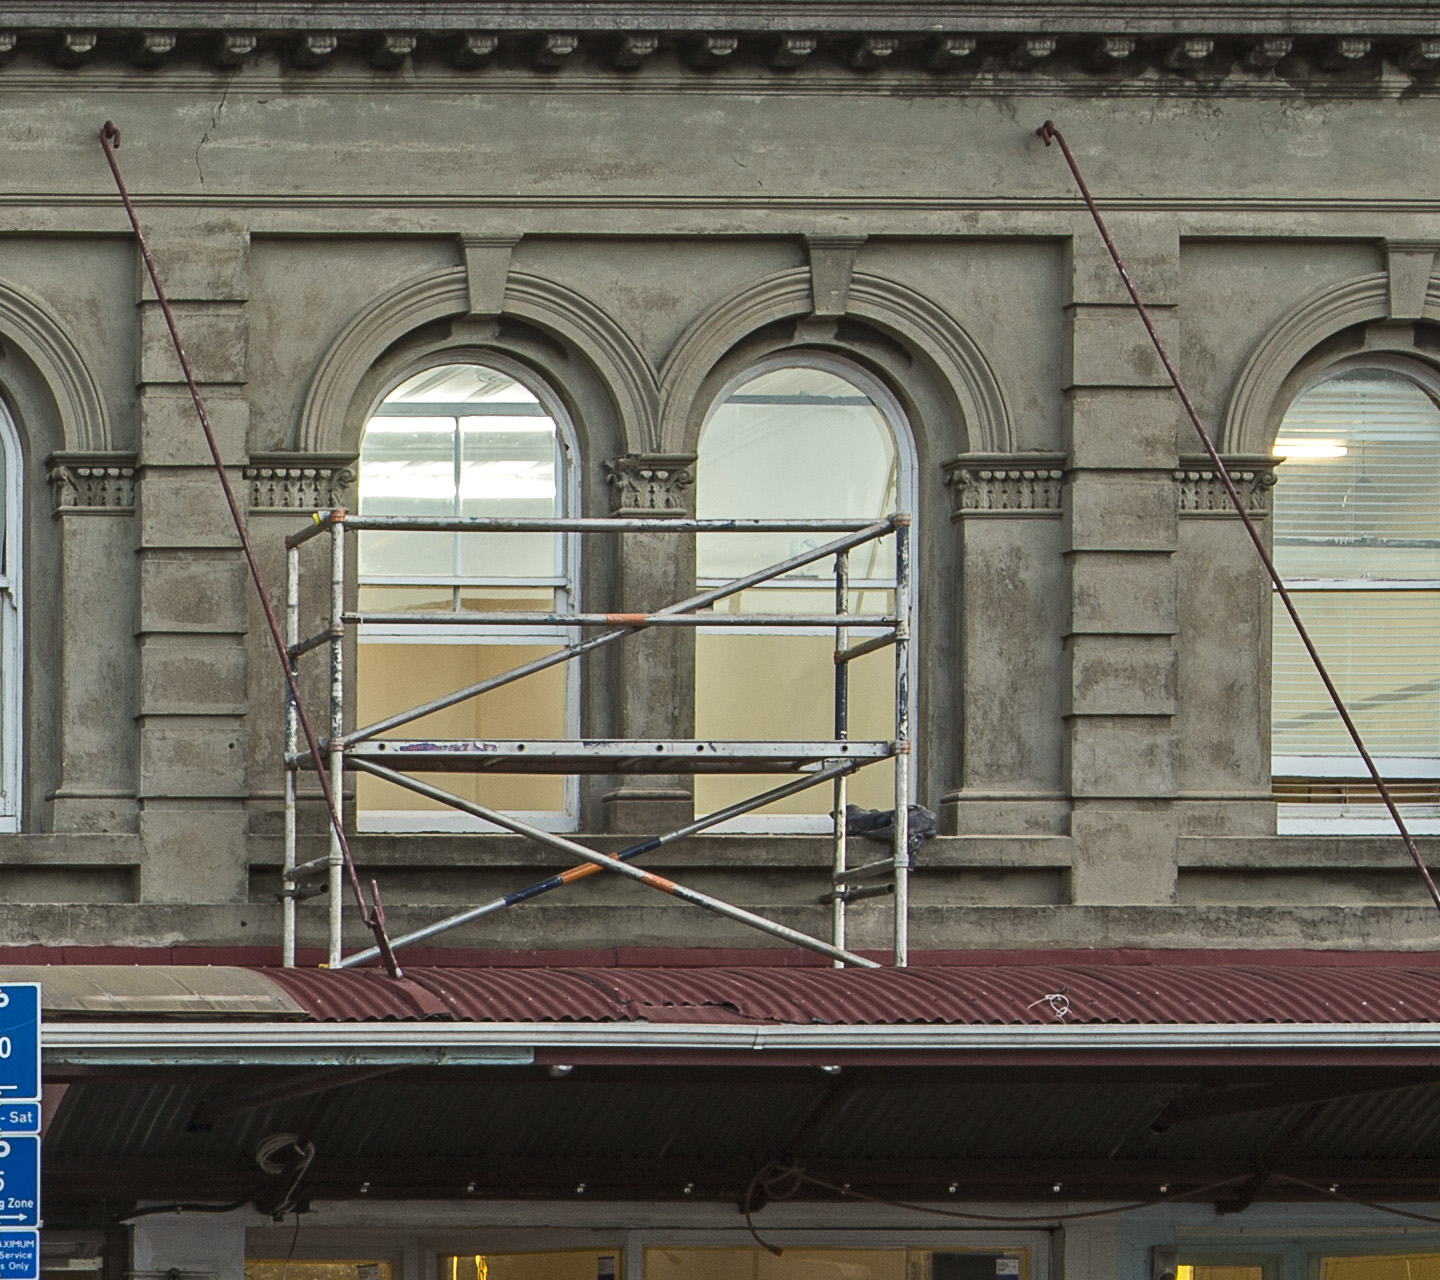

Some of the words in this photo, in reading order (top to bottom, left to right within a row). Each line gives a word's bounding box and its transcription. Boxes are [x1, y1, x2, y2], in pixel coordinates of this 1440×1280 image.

[9, 1111, 33, 1123] Sat
[7, 1198, 34, 1208] Zone
[0, 1251, 33, 1259] Service
[9, 1262, 30, 1271] Only
